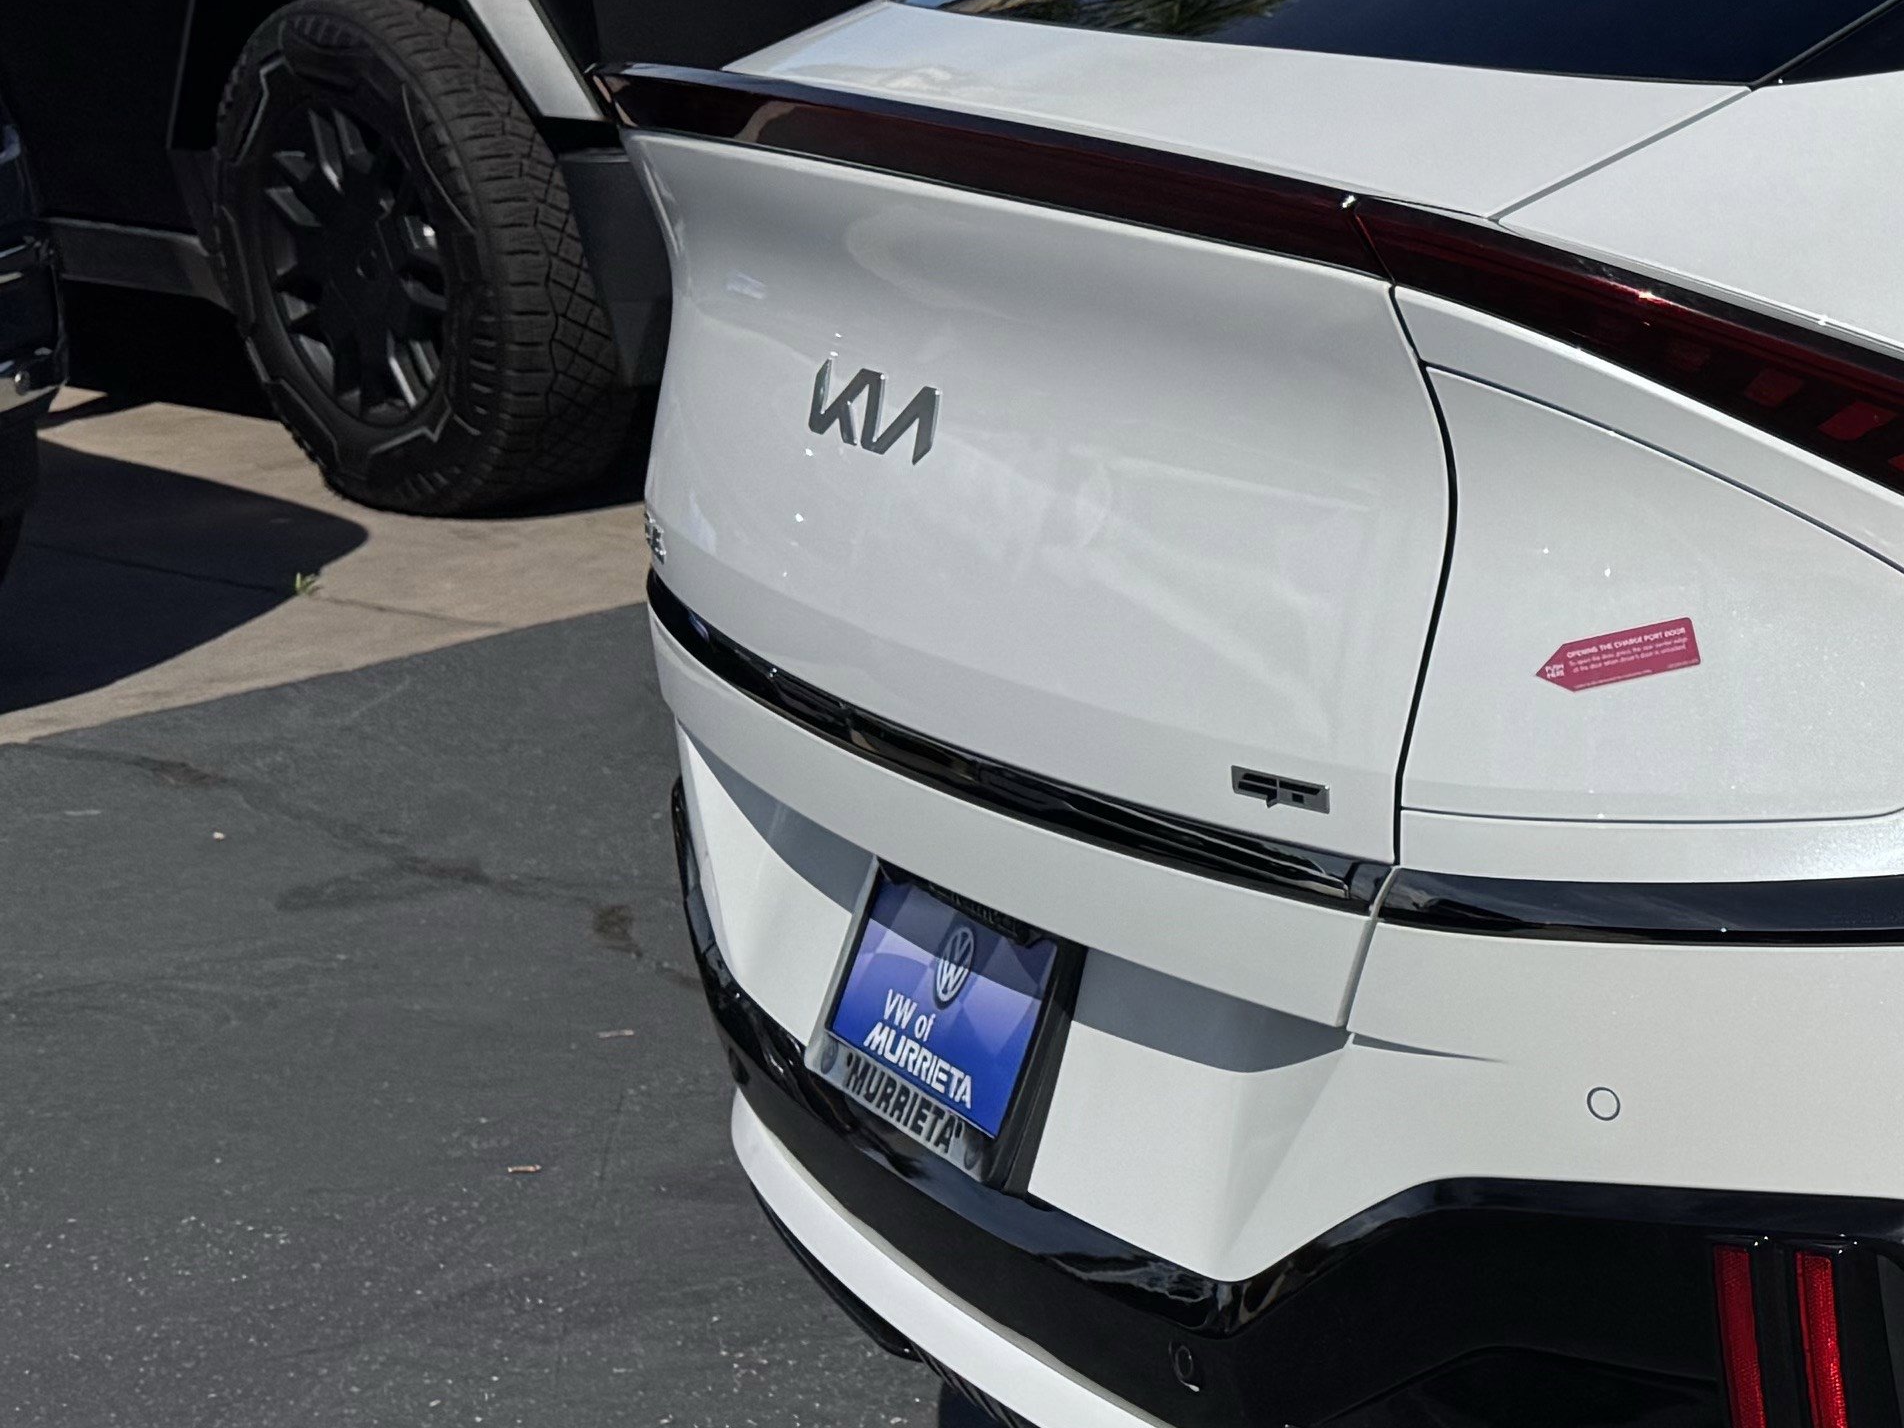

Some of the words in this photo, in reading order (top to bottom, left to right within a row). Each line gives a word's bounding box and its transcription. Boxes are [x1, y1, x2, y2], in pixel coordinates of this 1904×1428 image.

[808, 357, 941, 465] KIA
[884, 989, 917, 1029] VW
[914, 1014, 935, 1041] of
[863, 1023, 971, 1109] MURRIETA
